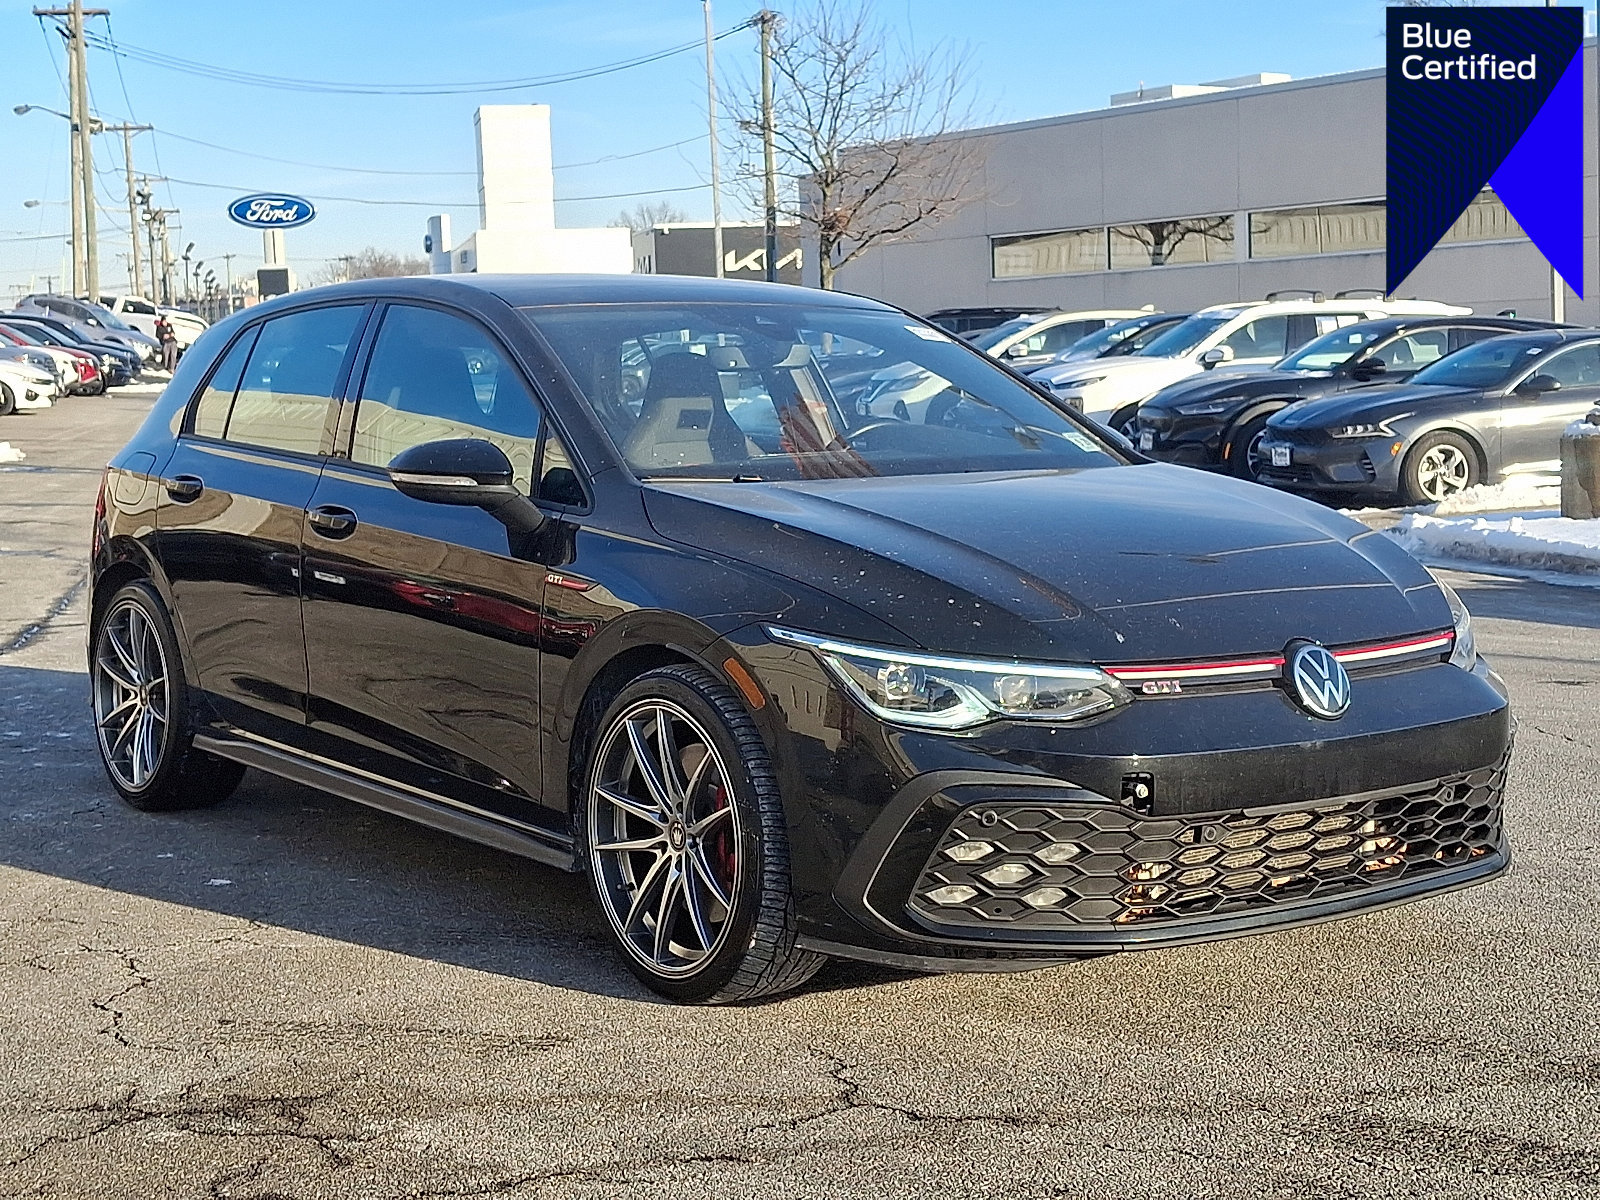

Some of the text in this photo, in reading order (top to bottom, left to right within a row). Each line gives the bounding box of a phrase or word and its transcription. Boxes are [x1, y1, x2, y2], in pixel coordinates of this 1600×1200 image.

[246, 199, 299, 222] Ford
[547, 574, 564, 585] GTI
[1142, 680, 1182, 695] GTI
